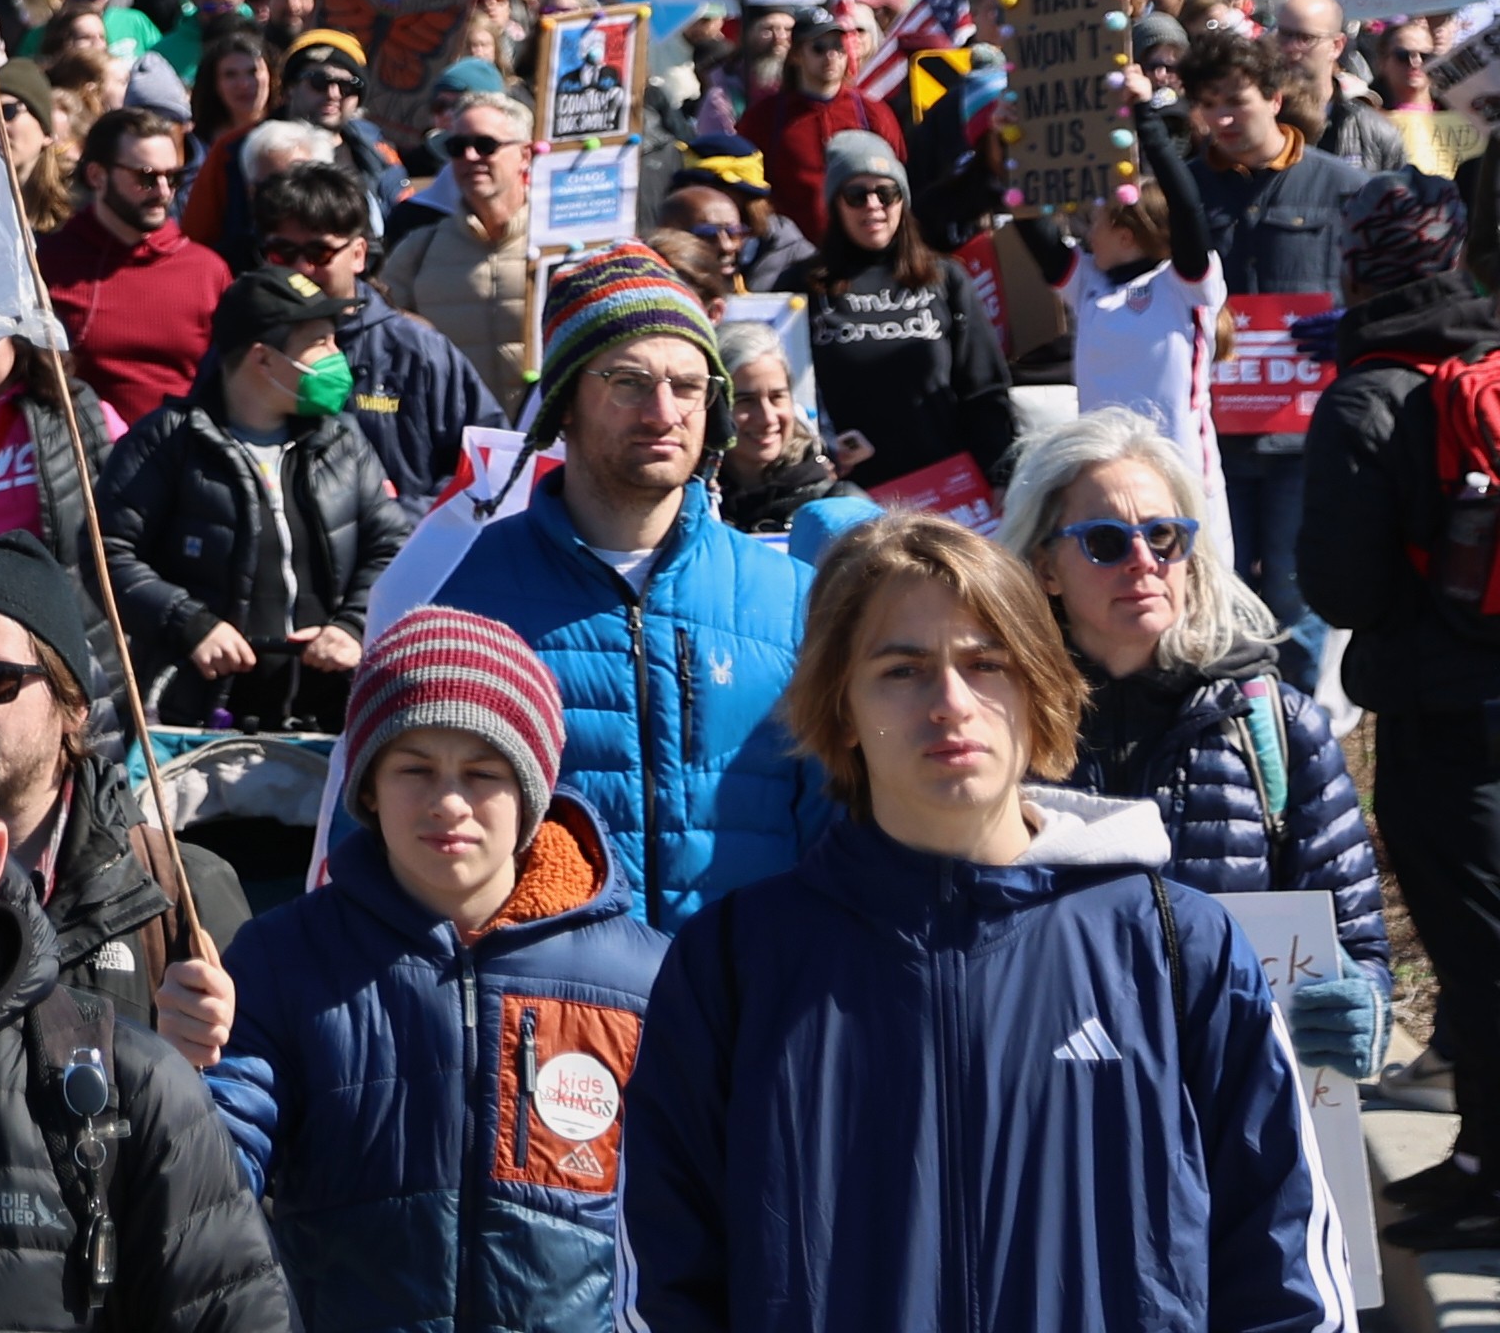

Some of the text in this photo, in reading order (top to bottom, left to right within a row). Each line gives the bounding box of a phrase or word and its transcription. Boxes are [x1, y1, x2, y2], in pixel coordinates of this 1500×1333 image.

[1018, 20, 1101, 69] WON'T
[1025, 78, 1108, 121] MAKE
[1047, 120, 1085, 158] US
[1432, 124, 1480, 151] AND
[1023, 163, 1111, 206] GREAT
[845, 288, 937, 312] miss
[813, 309, 943, 344] barack
[1267, 358, 1322, 385] DC
[558, 1070, 605, 1095] kids
[556, 1090, 615, 1119] KINGS
